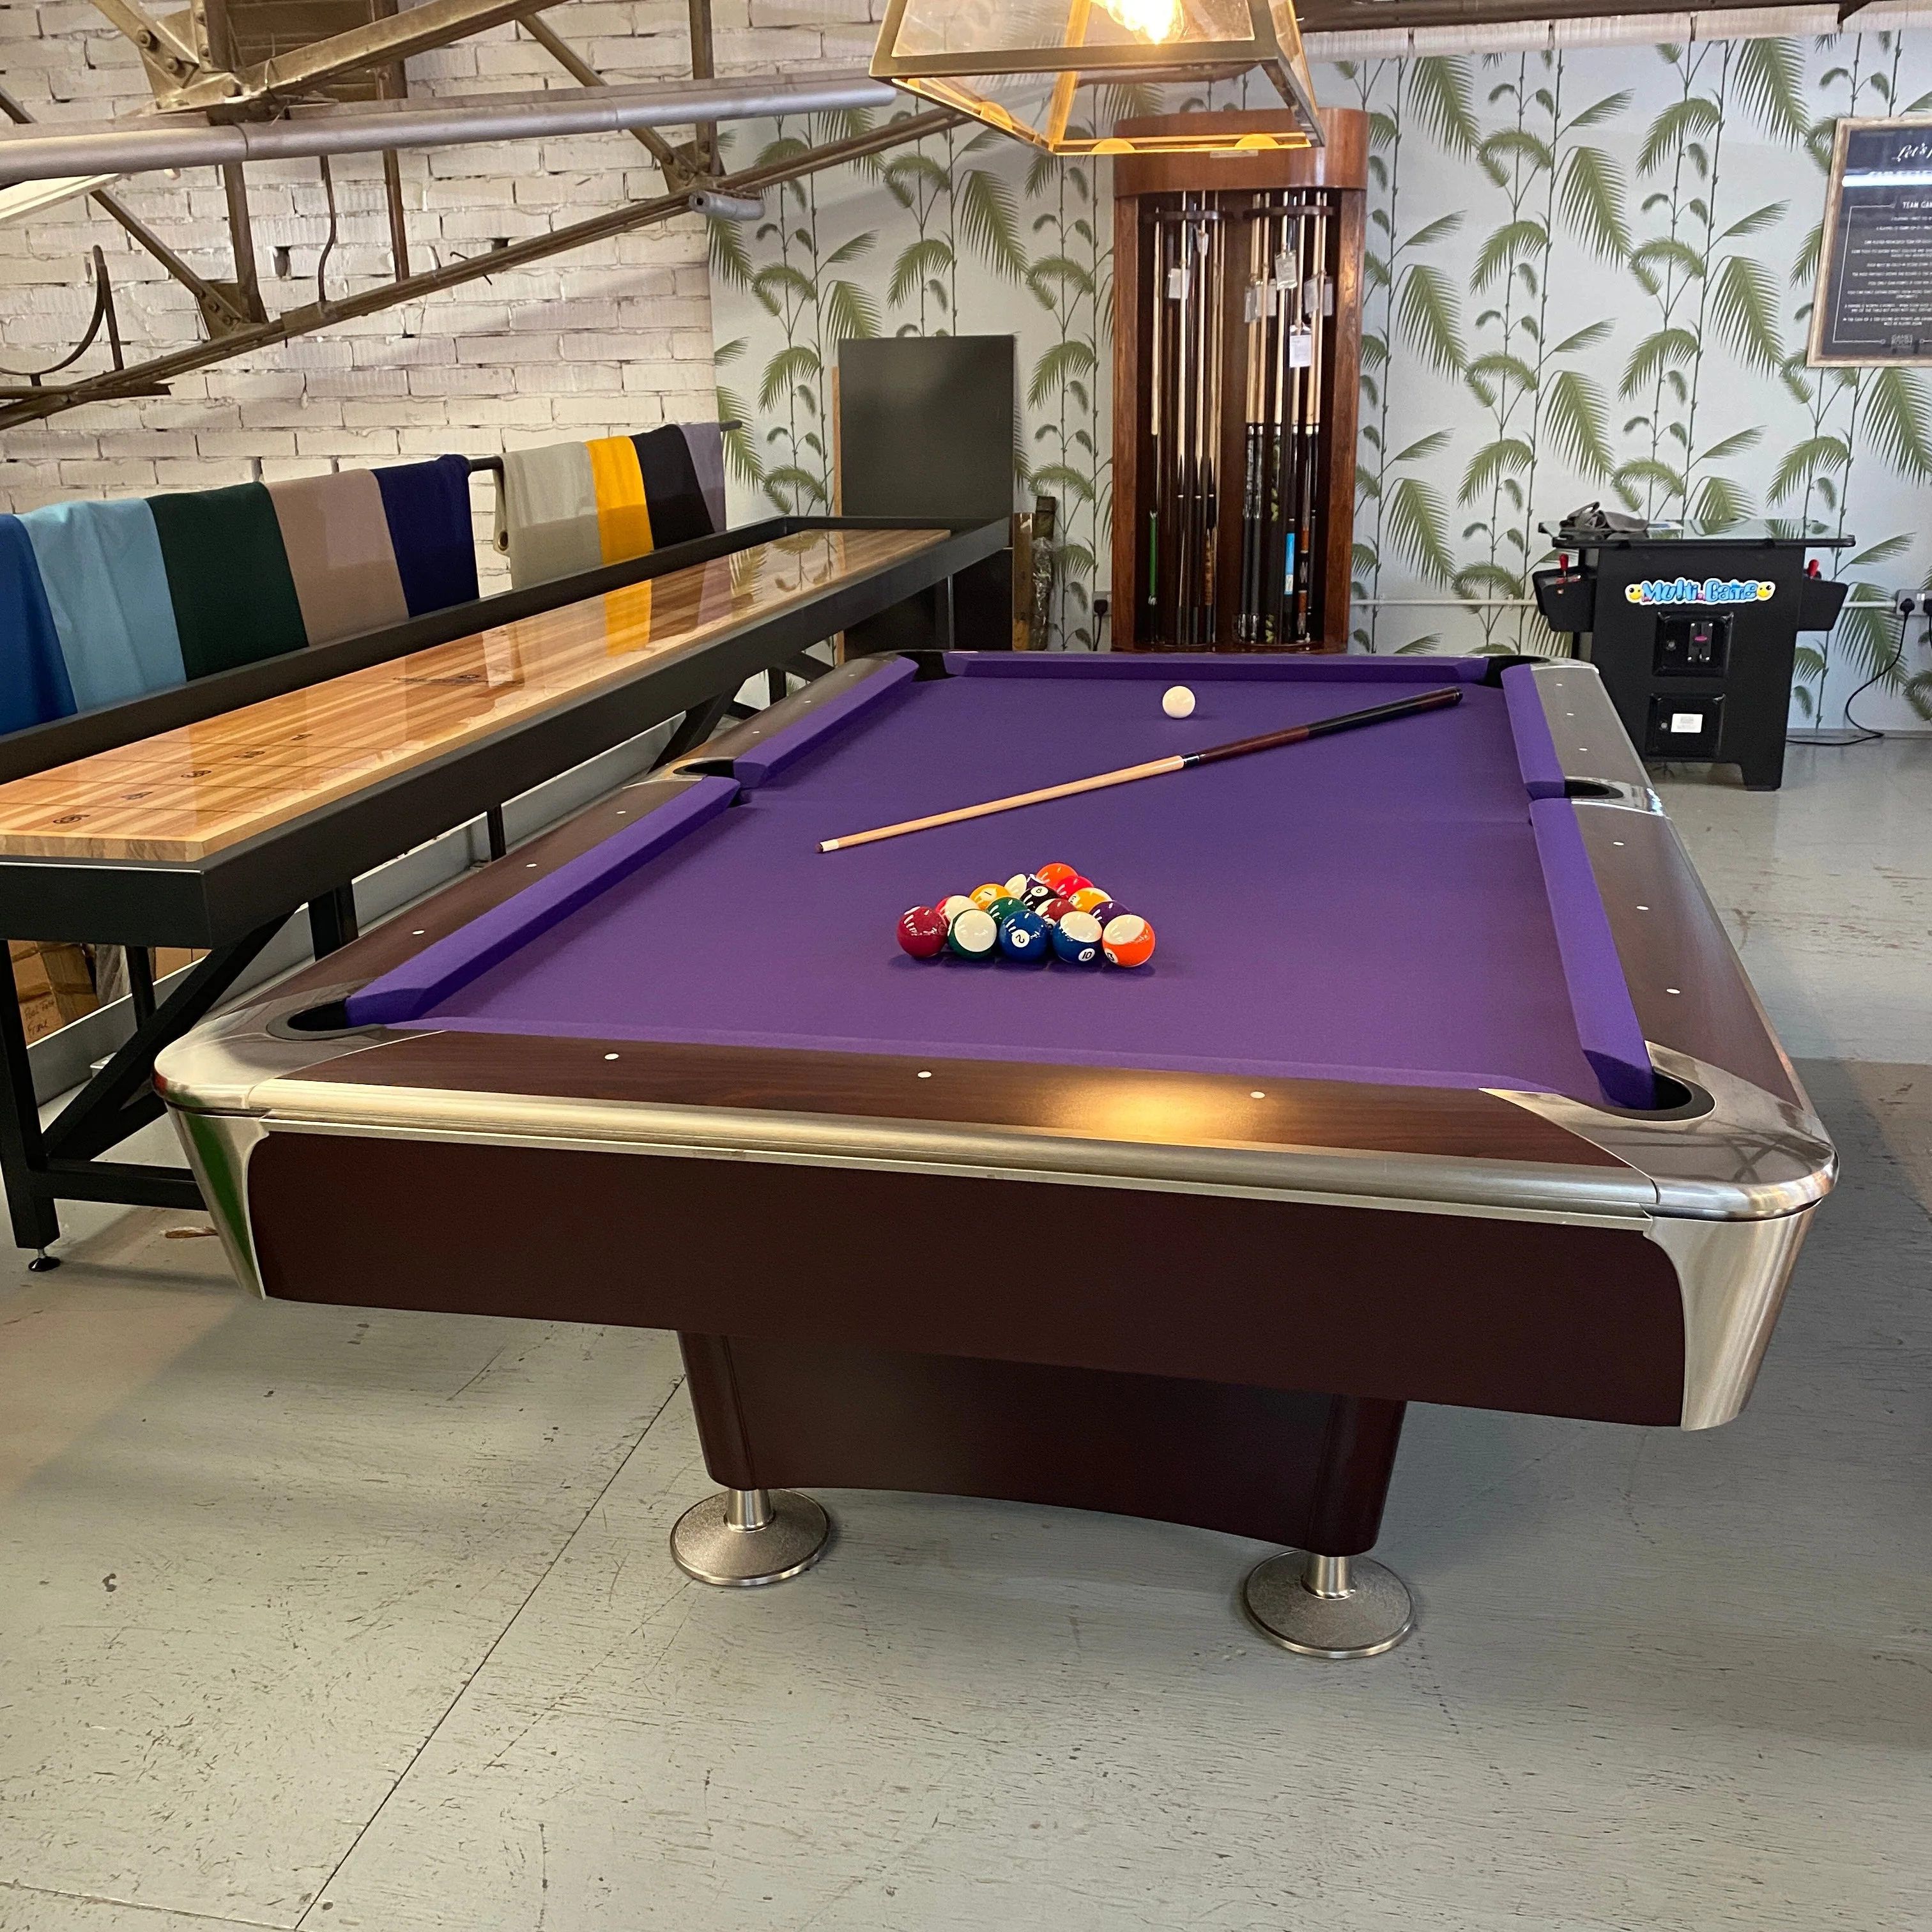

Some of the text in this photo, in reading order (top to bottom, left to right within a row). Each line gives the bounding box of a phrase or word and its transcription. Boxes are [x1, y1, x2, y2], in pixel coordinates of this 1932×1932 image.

[1642, 579, 1698, 602] Multi
[1015, 934, 1025, 944] 2
[1082, 951, 1092, 960] 10
